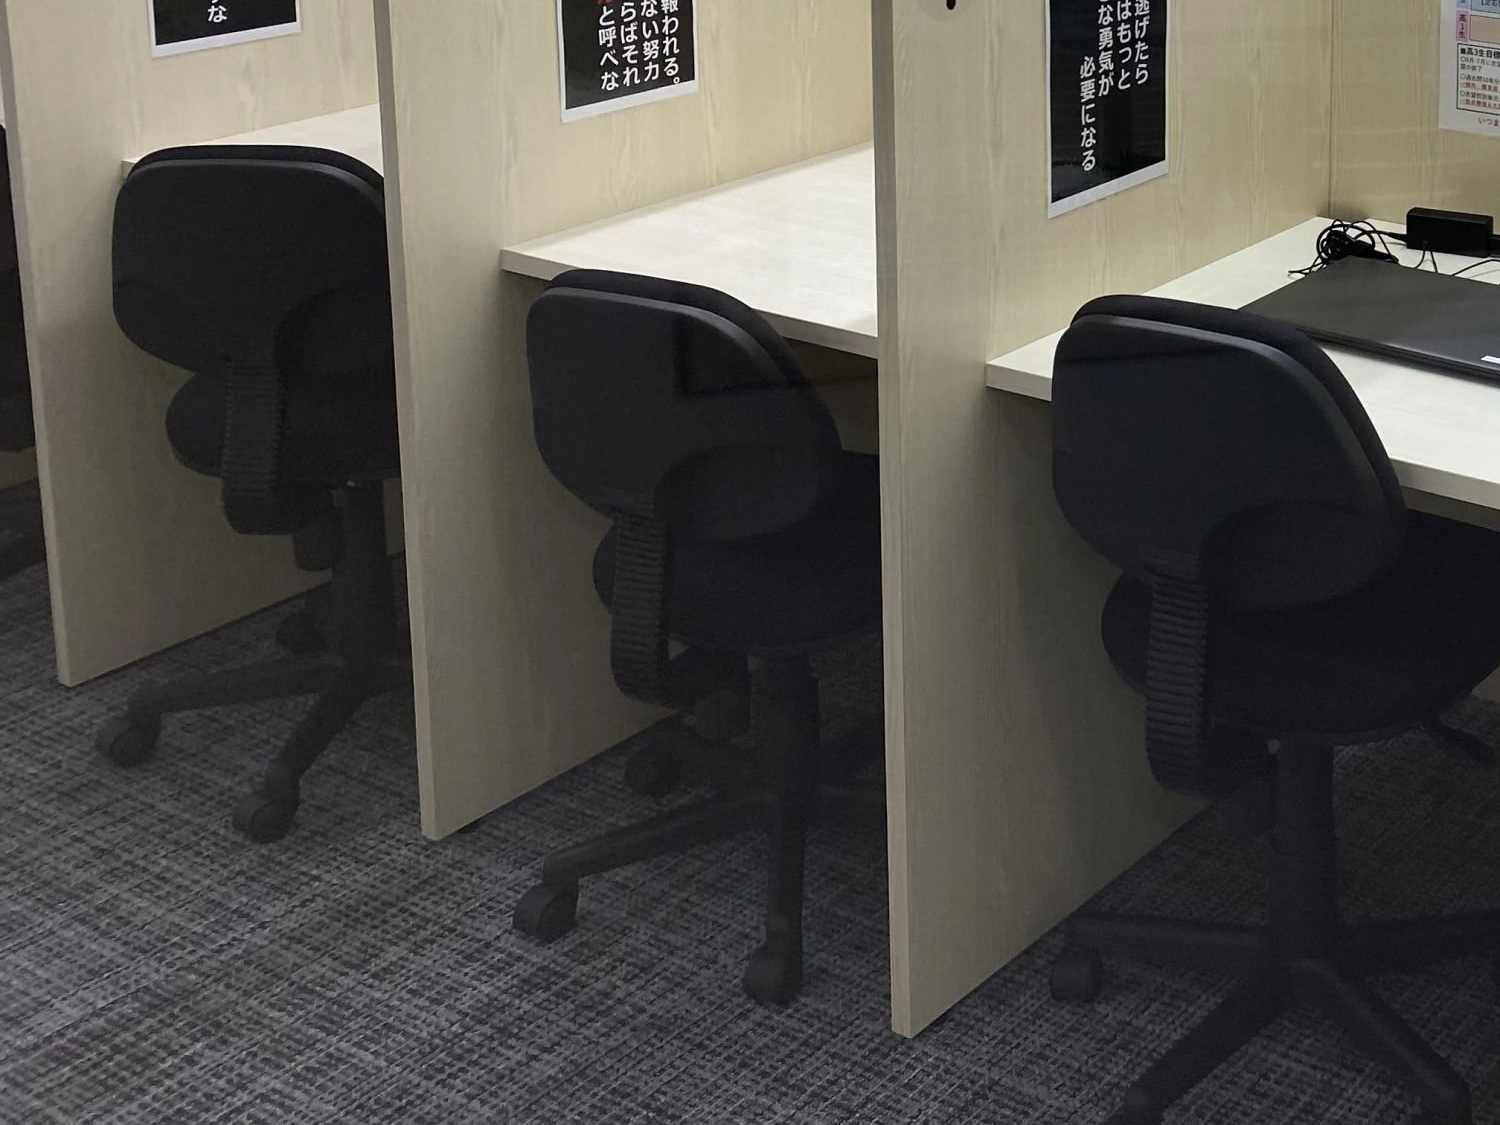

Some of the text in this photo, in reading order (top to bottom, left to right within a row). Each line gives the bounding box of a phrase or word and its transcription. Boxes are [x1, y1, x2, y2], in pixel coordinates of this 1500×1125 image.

[1458, 14, 1467, 39] 高1生
[1079, 56, 1096, 172] 必要になる
